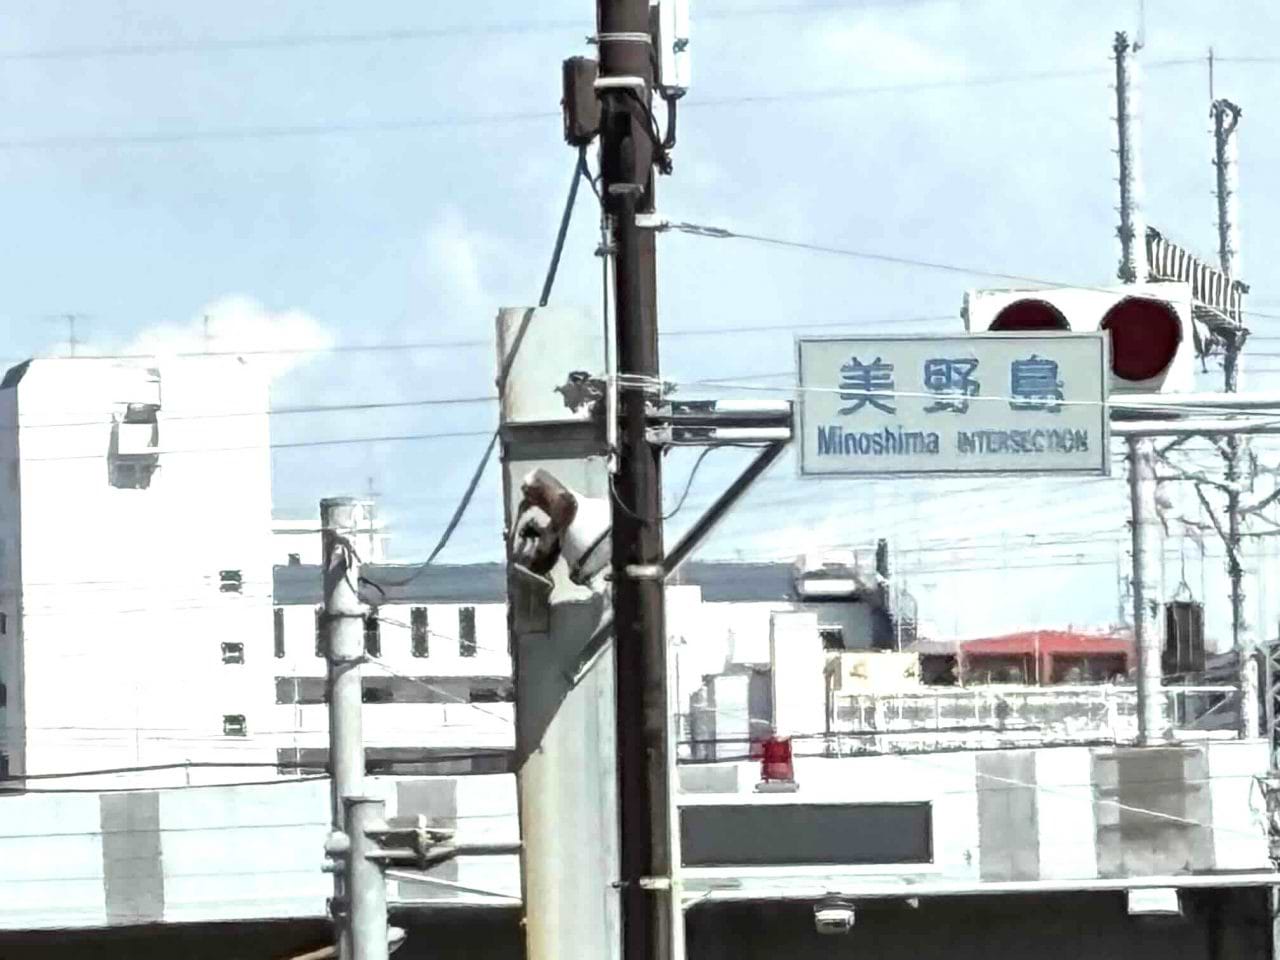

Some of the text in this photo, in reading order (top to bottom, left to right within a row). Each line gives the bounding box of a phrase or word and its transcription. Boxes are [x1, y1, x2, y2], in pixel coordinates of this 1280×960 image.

[838, 354, 1065, 415] 美野島
[817, 425, 1089, 456] Minoshima INTERSECTION
